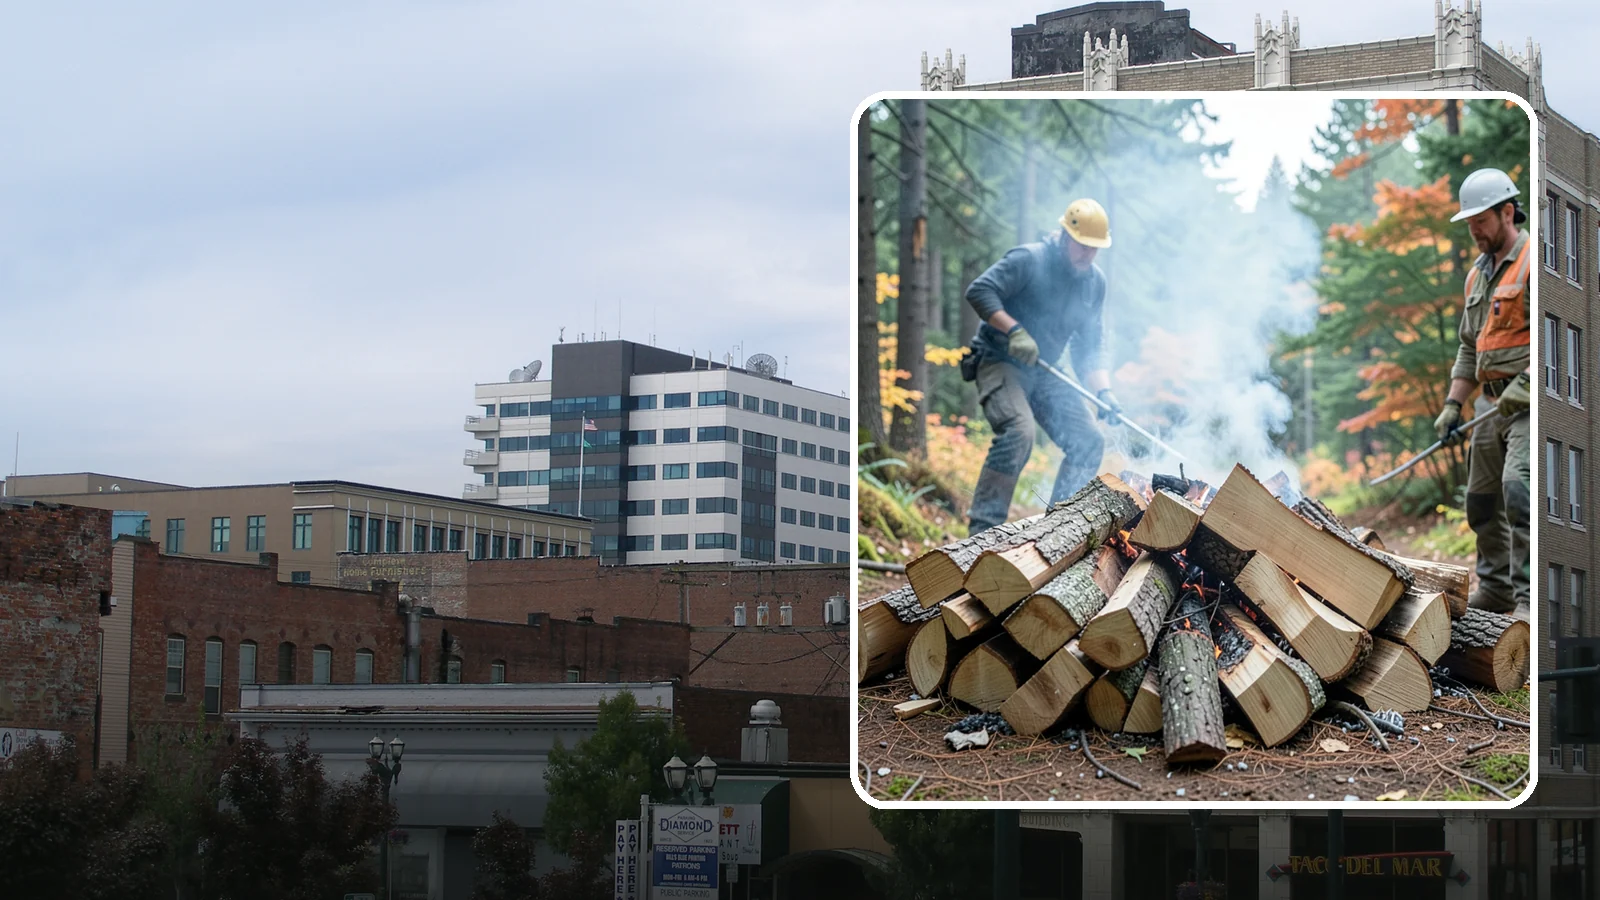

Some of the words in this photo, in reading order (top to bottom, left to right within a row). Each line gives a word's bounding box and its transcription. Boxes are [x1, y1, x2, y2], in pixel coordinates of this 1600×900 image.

[370, 566, 427, 577] Furnishers
[660, 818, 713, 833] DIAMOND
[1022, 815, 1070, 828] BUILDING
[617, 824, 625, 853] PAY
[628, 824, 637, 853] PAY
[656, 845, 688, 853] RESERVED
[689, 846, 716, 854] PARKING
[671, 862, 701, 870] PATRONS
[1346, 856, 1385, 875] DEL
[1392, 858, 1442, 877] MAR
[616, 856, 625, 893] HERE
[627, 855, 636, 893] HERE
[660, 888, 682, 897] PUBLIC
[683, 889, 710, 898] PARKING
